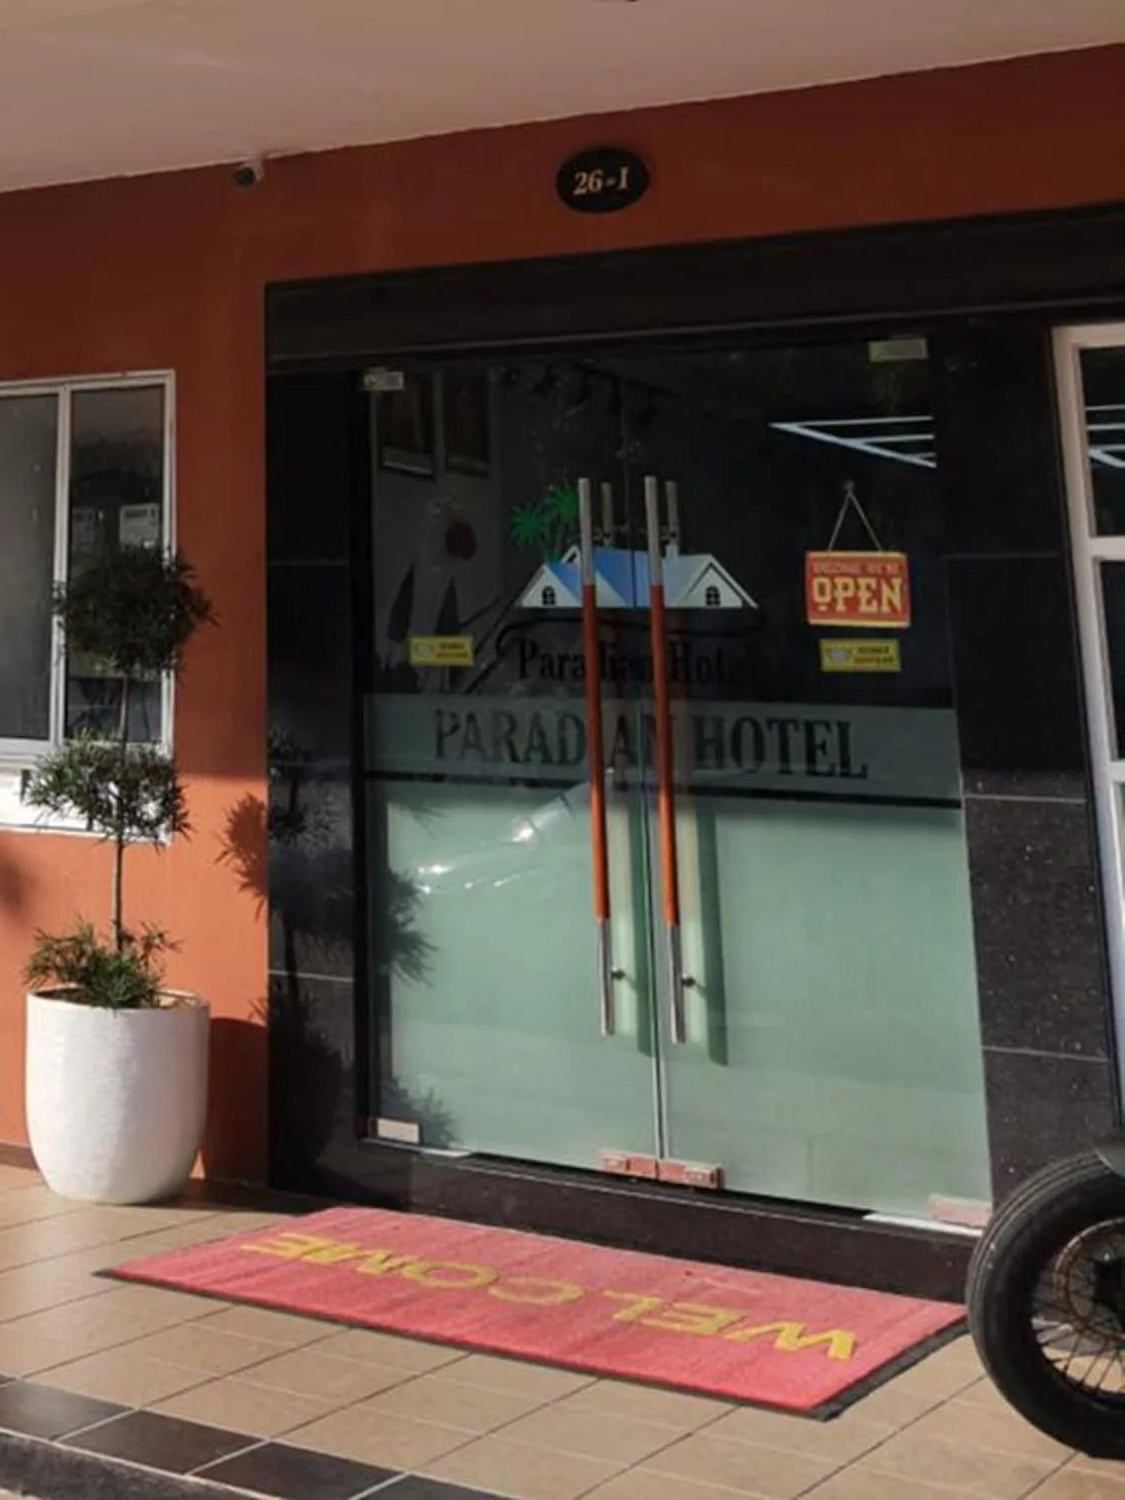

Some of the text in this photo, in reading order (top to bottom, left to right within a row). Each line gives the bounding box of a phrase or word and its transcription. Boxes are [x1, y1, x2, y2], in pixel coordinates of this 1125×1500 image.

[573, 166, 629, 196] 26-1
[812, 576, 903, 614] OPEN
[692, 714, 869, 780] HOTEL
[240, 1231, 858, 1363] WELCOME
